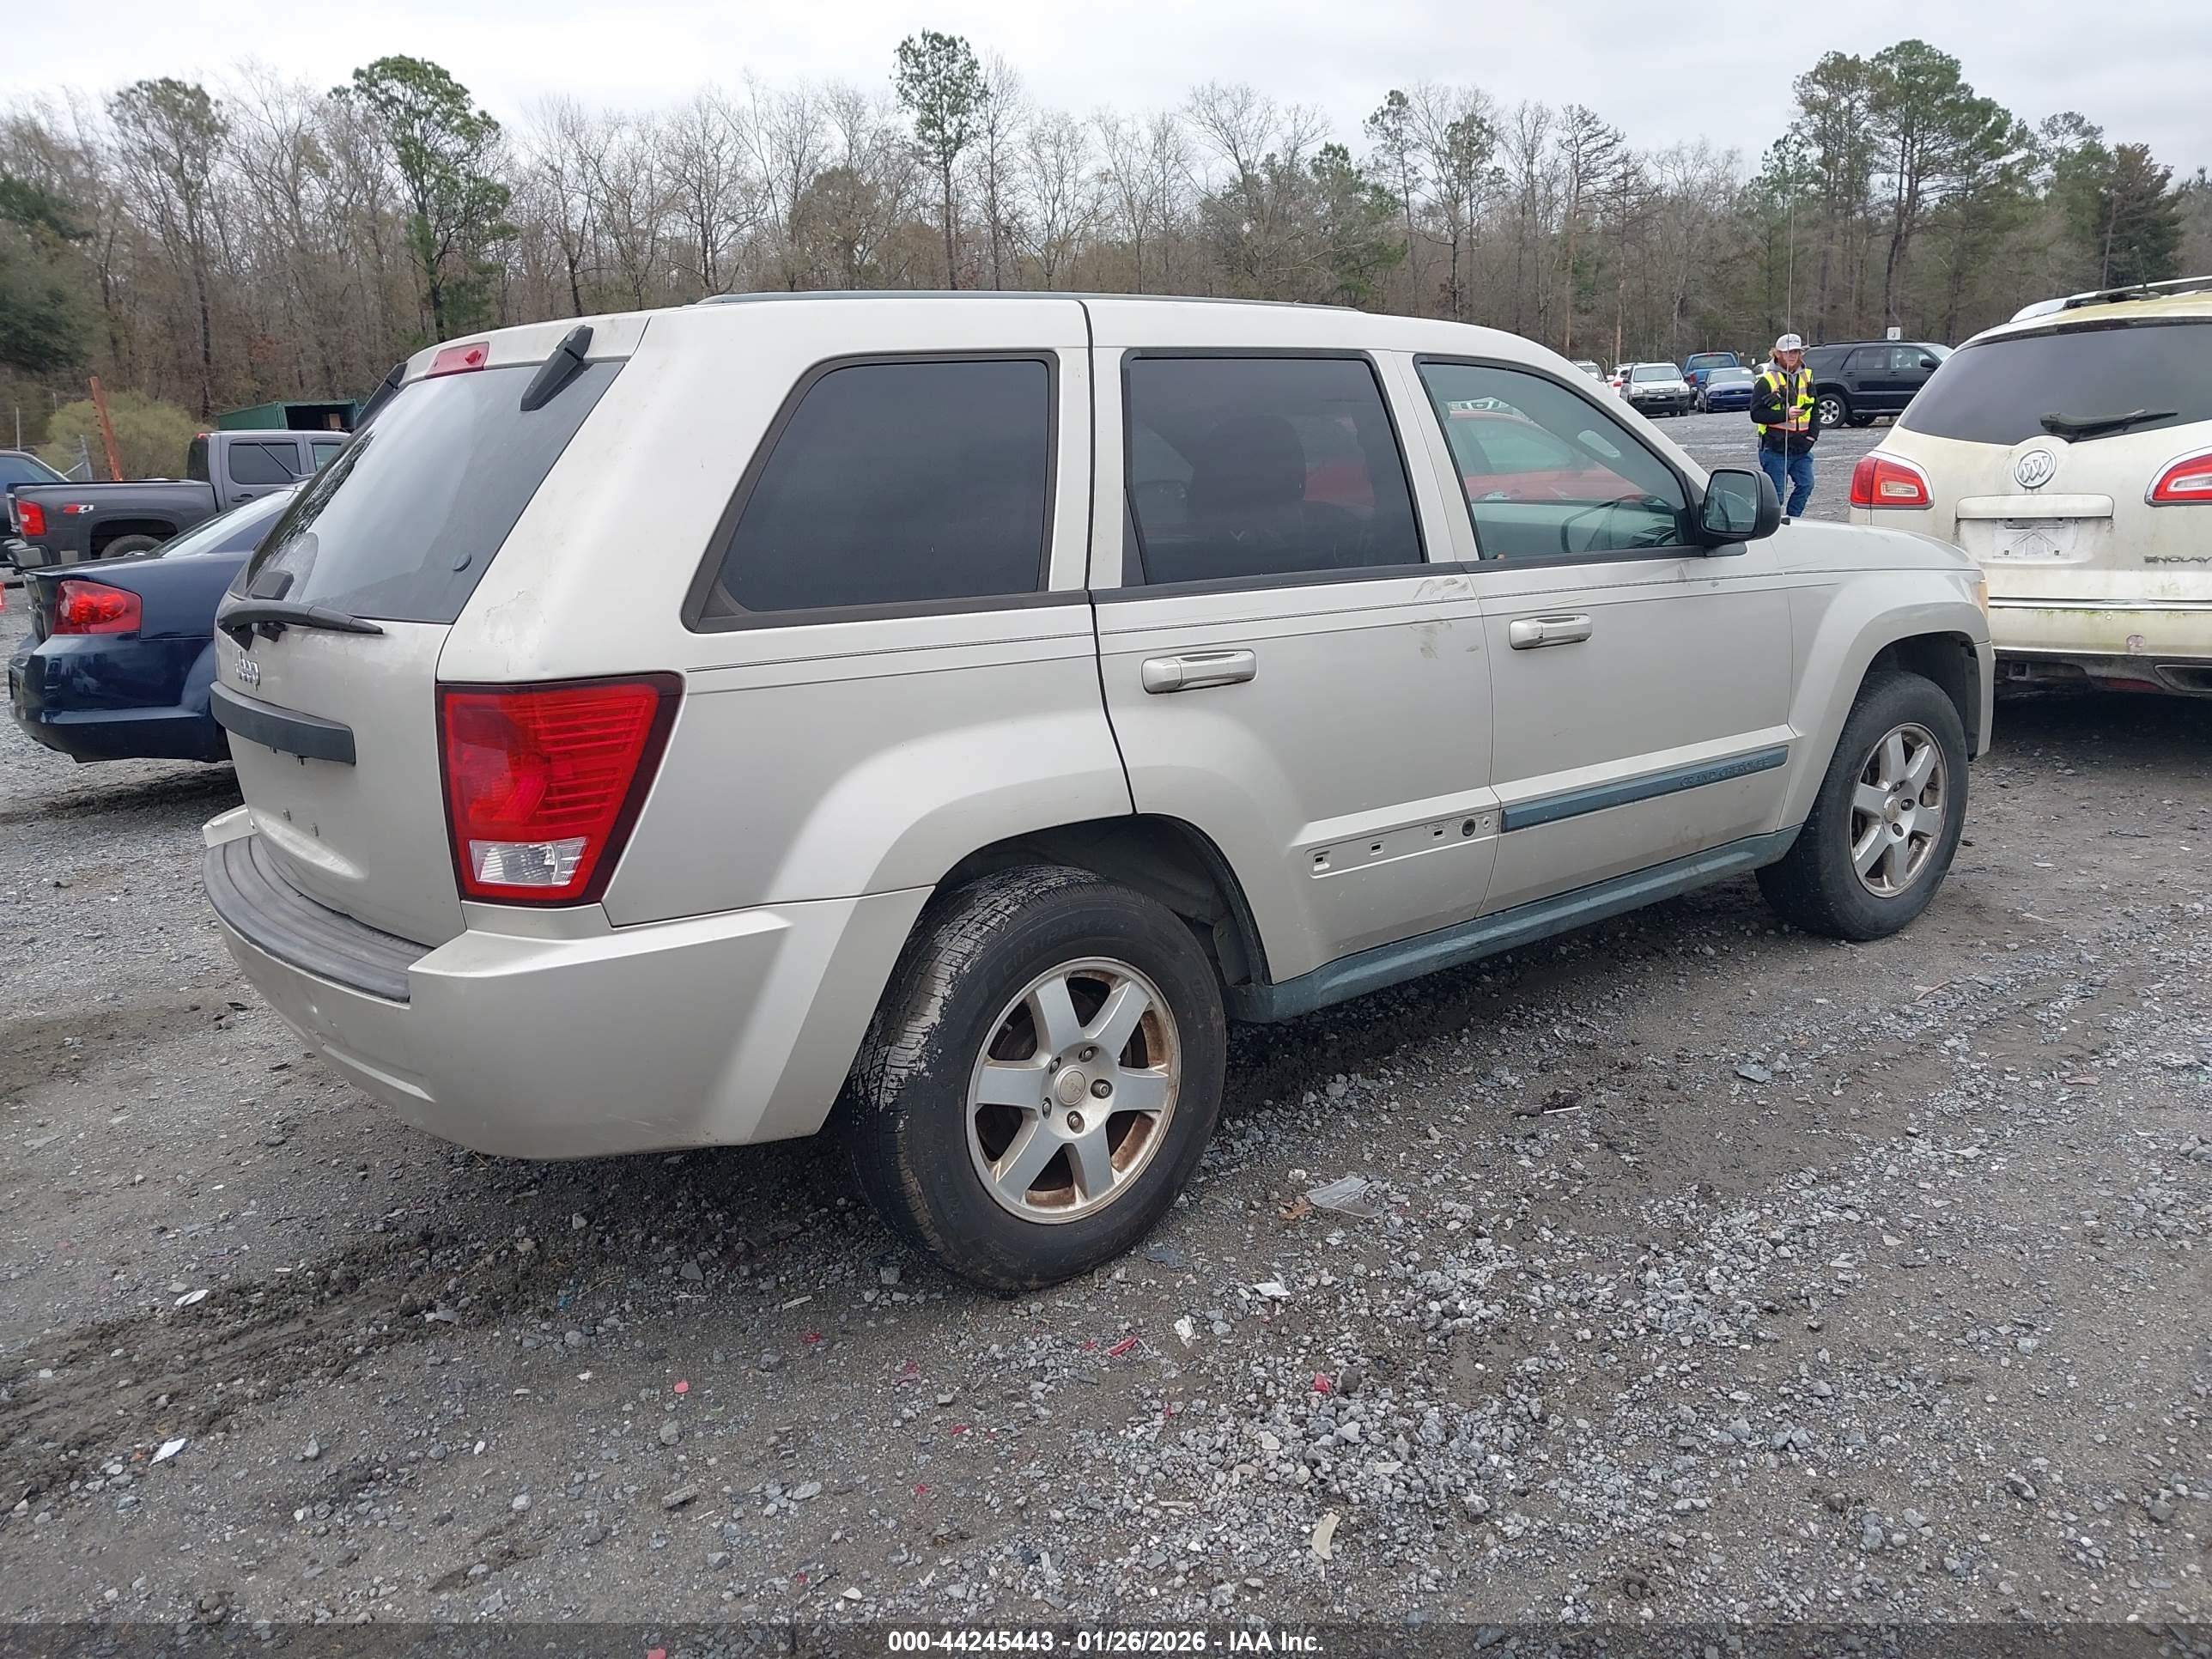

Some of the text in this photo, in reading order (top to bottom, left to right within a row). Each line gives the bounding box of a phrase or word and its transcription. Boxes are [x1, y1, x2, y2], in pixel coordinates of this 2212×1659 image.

[2144, 556, 2212, 564] ENCLAV
[234, 649, 260, 691] Jeep
[1680, 757, 1771, 787] GRAND CHEROKEE
